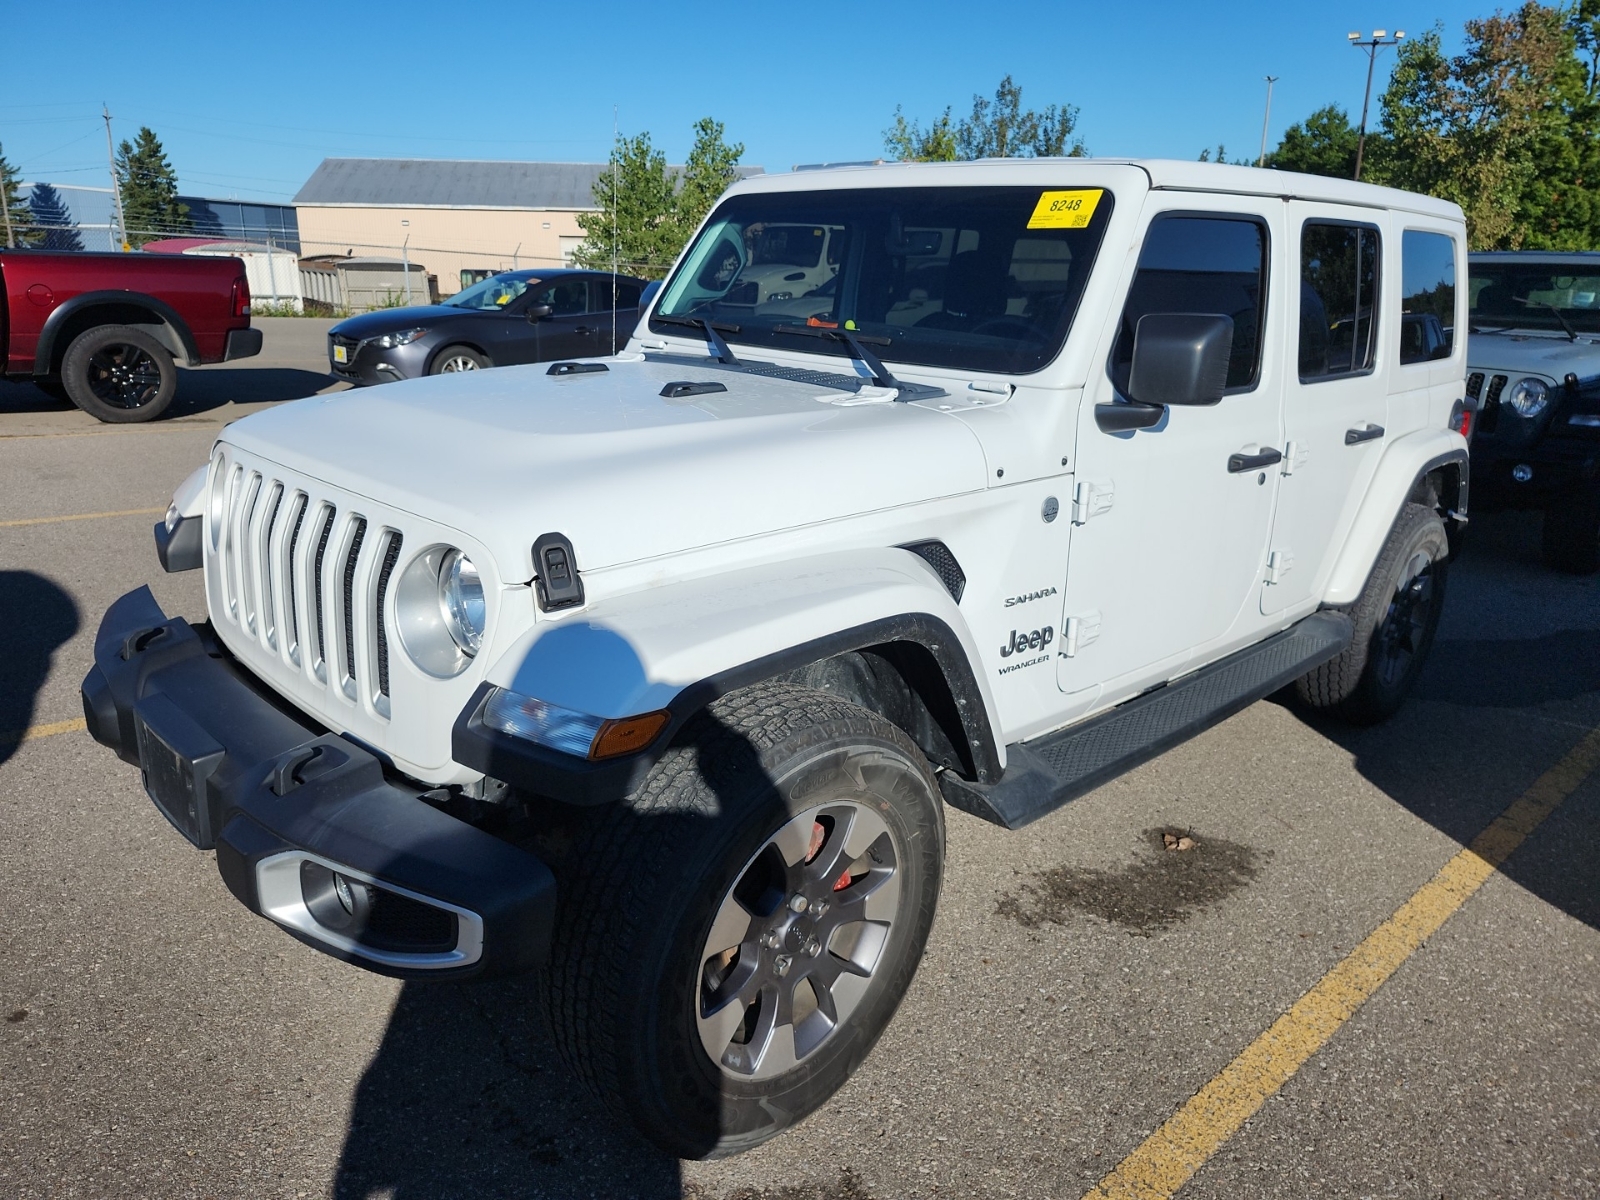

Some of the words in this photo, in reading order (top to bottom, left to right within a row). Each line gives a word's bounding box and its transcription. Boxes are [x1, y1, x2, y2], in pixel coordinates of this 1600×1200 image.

[1049, 199, 1083, 212] 8248
[1003, 586, 1058, 608] SAHARA
[999, 625, 1054, 658] Jeep
[998, 654, 1050, 676] WRANGLER
